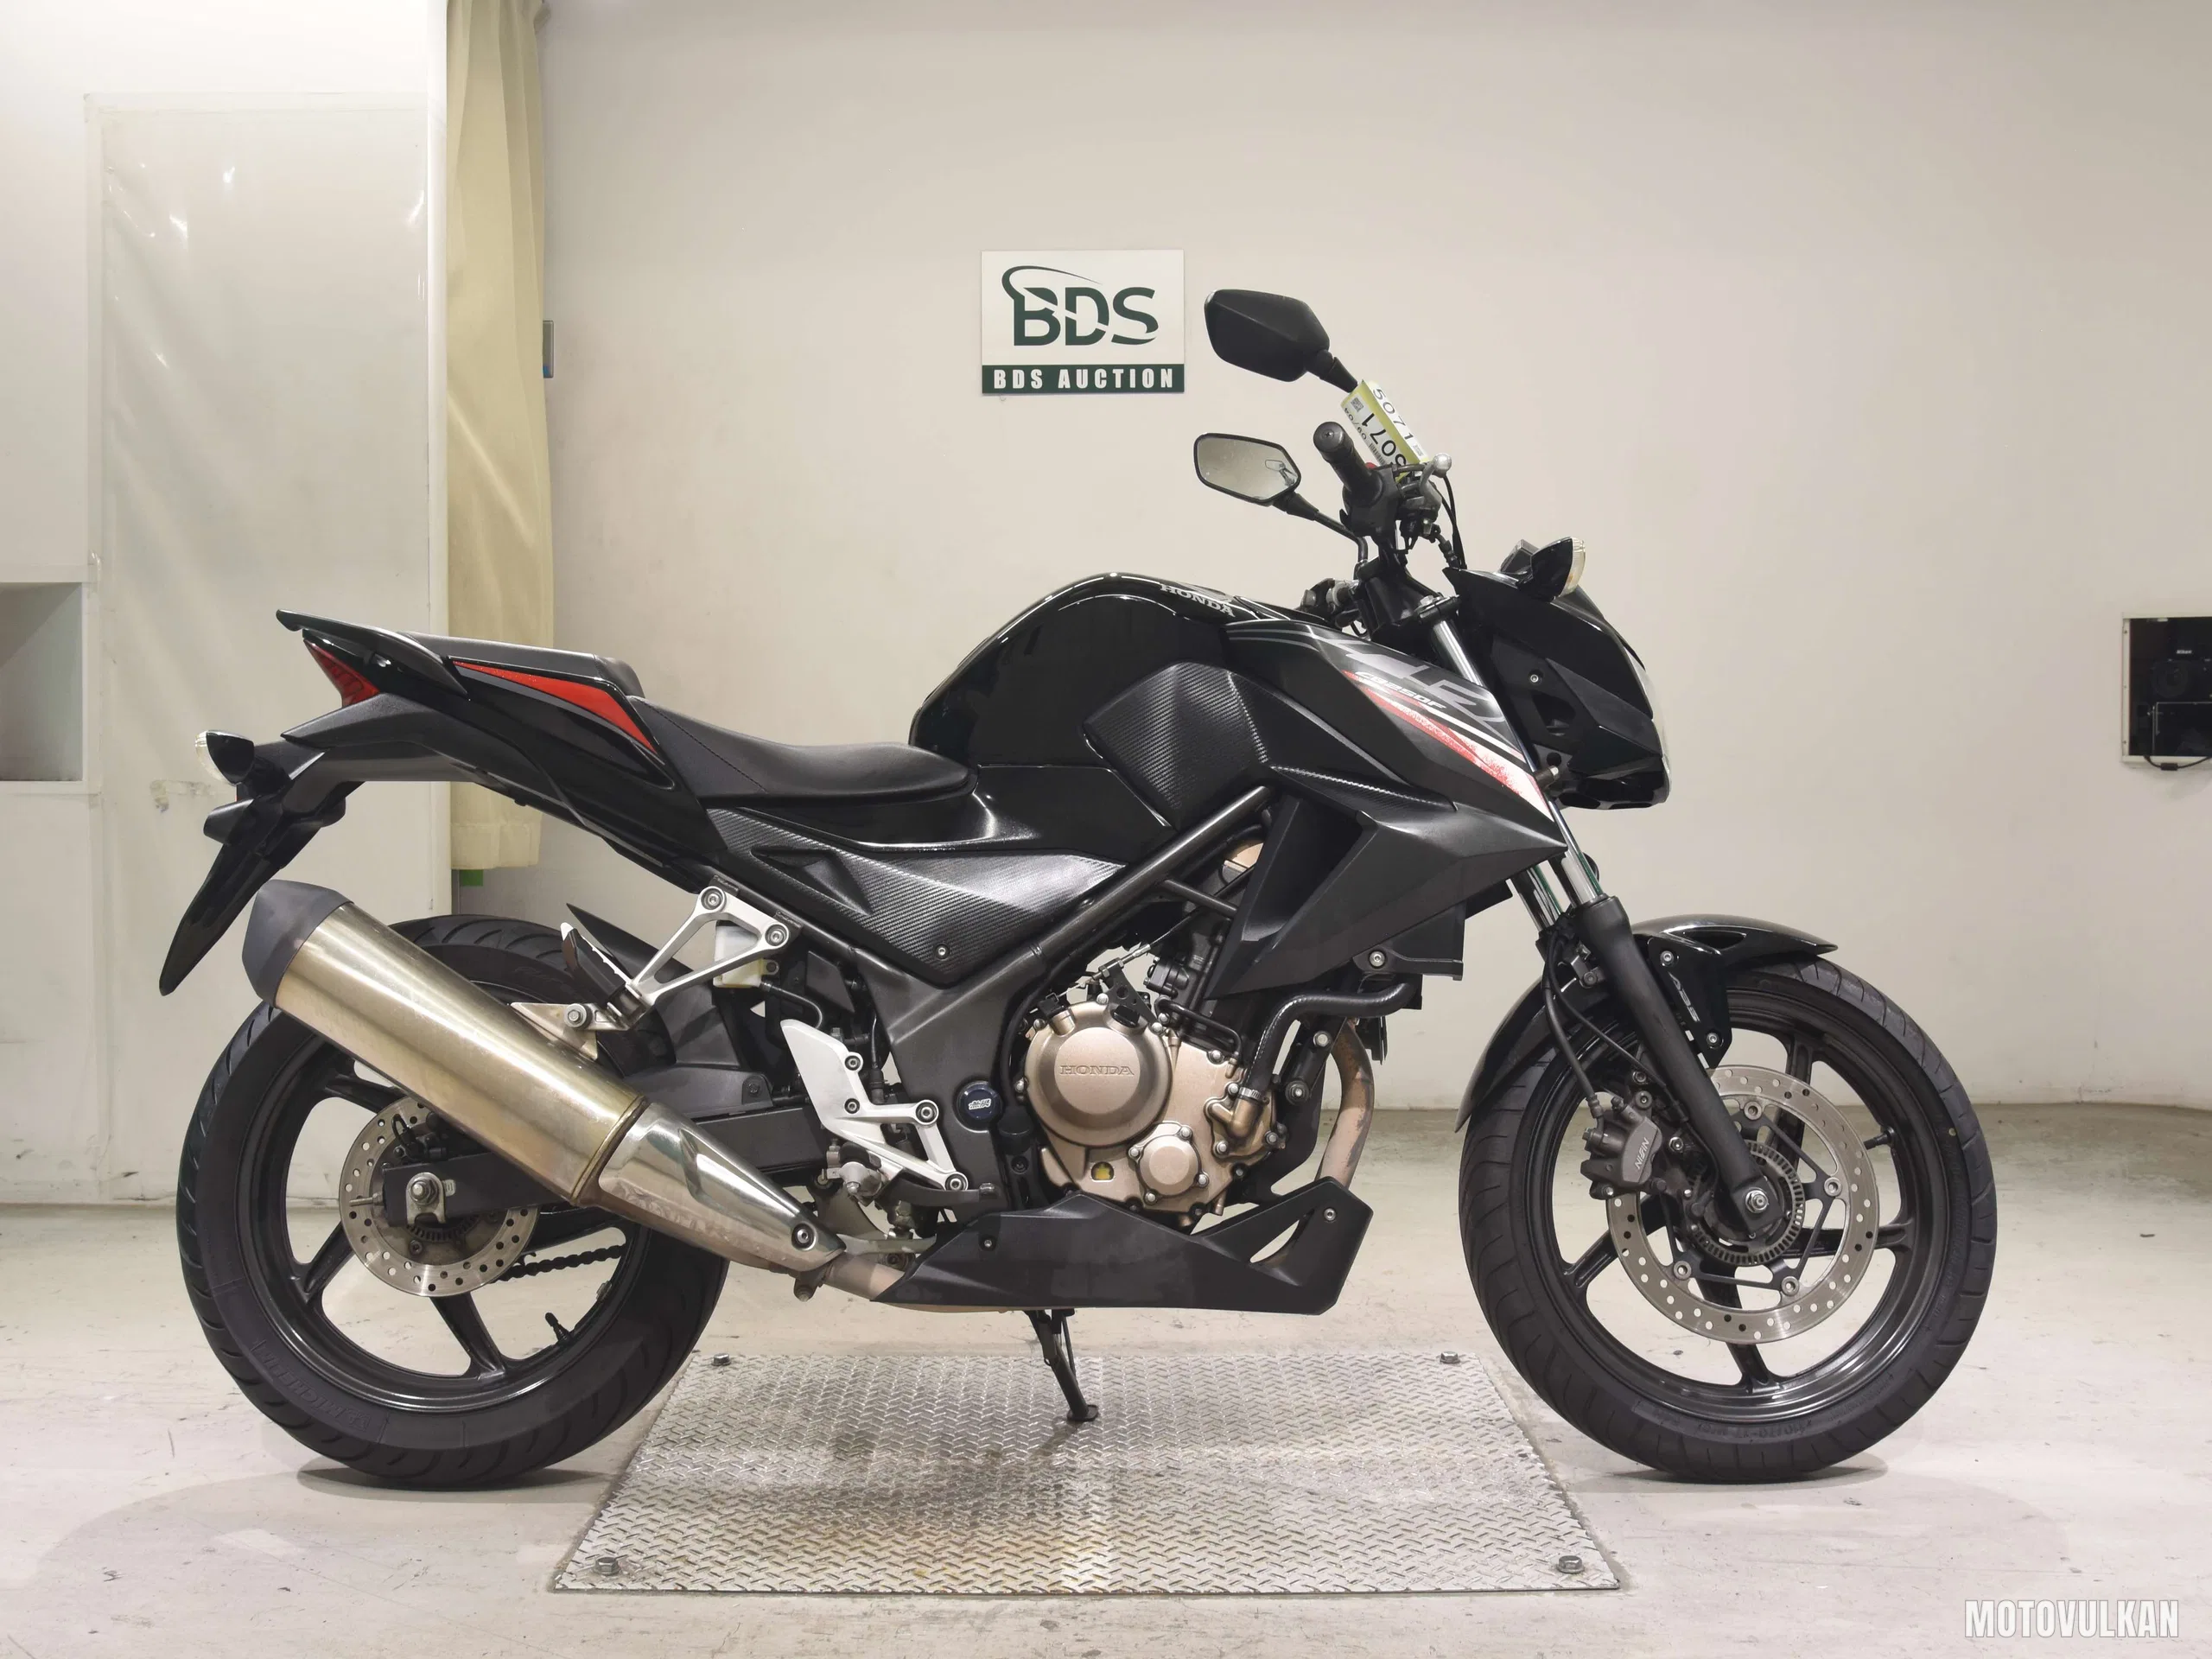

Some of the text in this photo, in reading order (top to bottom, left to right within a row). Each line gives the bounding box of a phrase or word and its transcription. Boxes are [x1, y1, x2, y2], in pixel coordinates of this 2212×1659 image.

[1001, 265, 1159, 346] BDS
[994, 368, 1173, 389] BDS AUCTION
[1373, 388, 1414, 440] 5071
[1160, 583, 1236, 618] HONDA
[1354, 671, 1447, 709] CB250F
[1669, 972, 1700, 1022] ABS
[1059, 1065, 1135, 1077] HONDA
